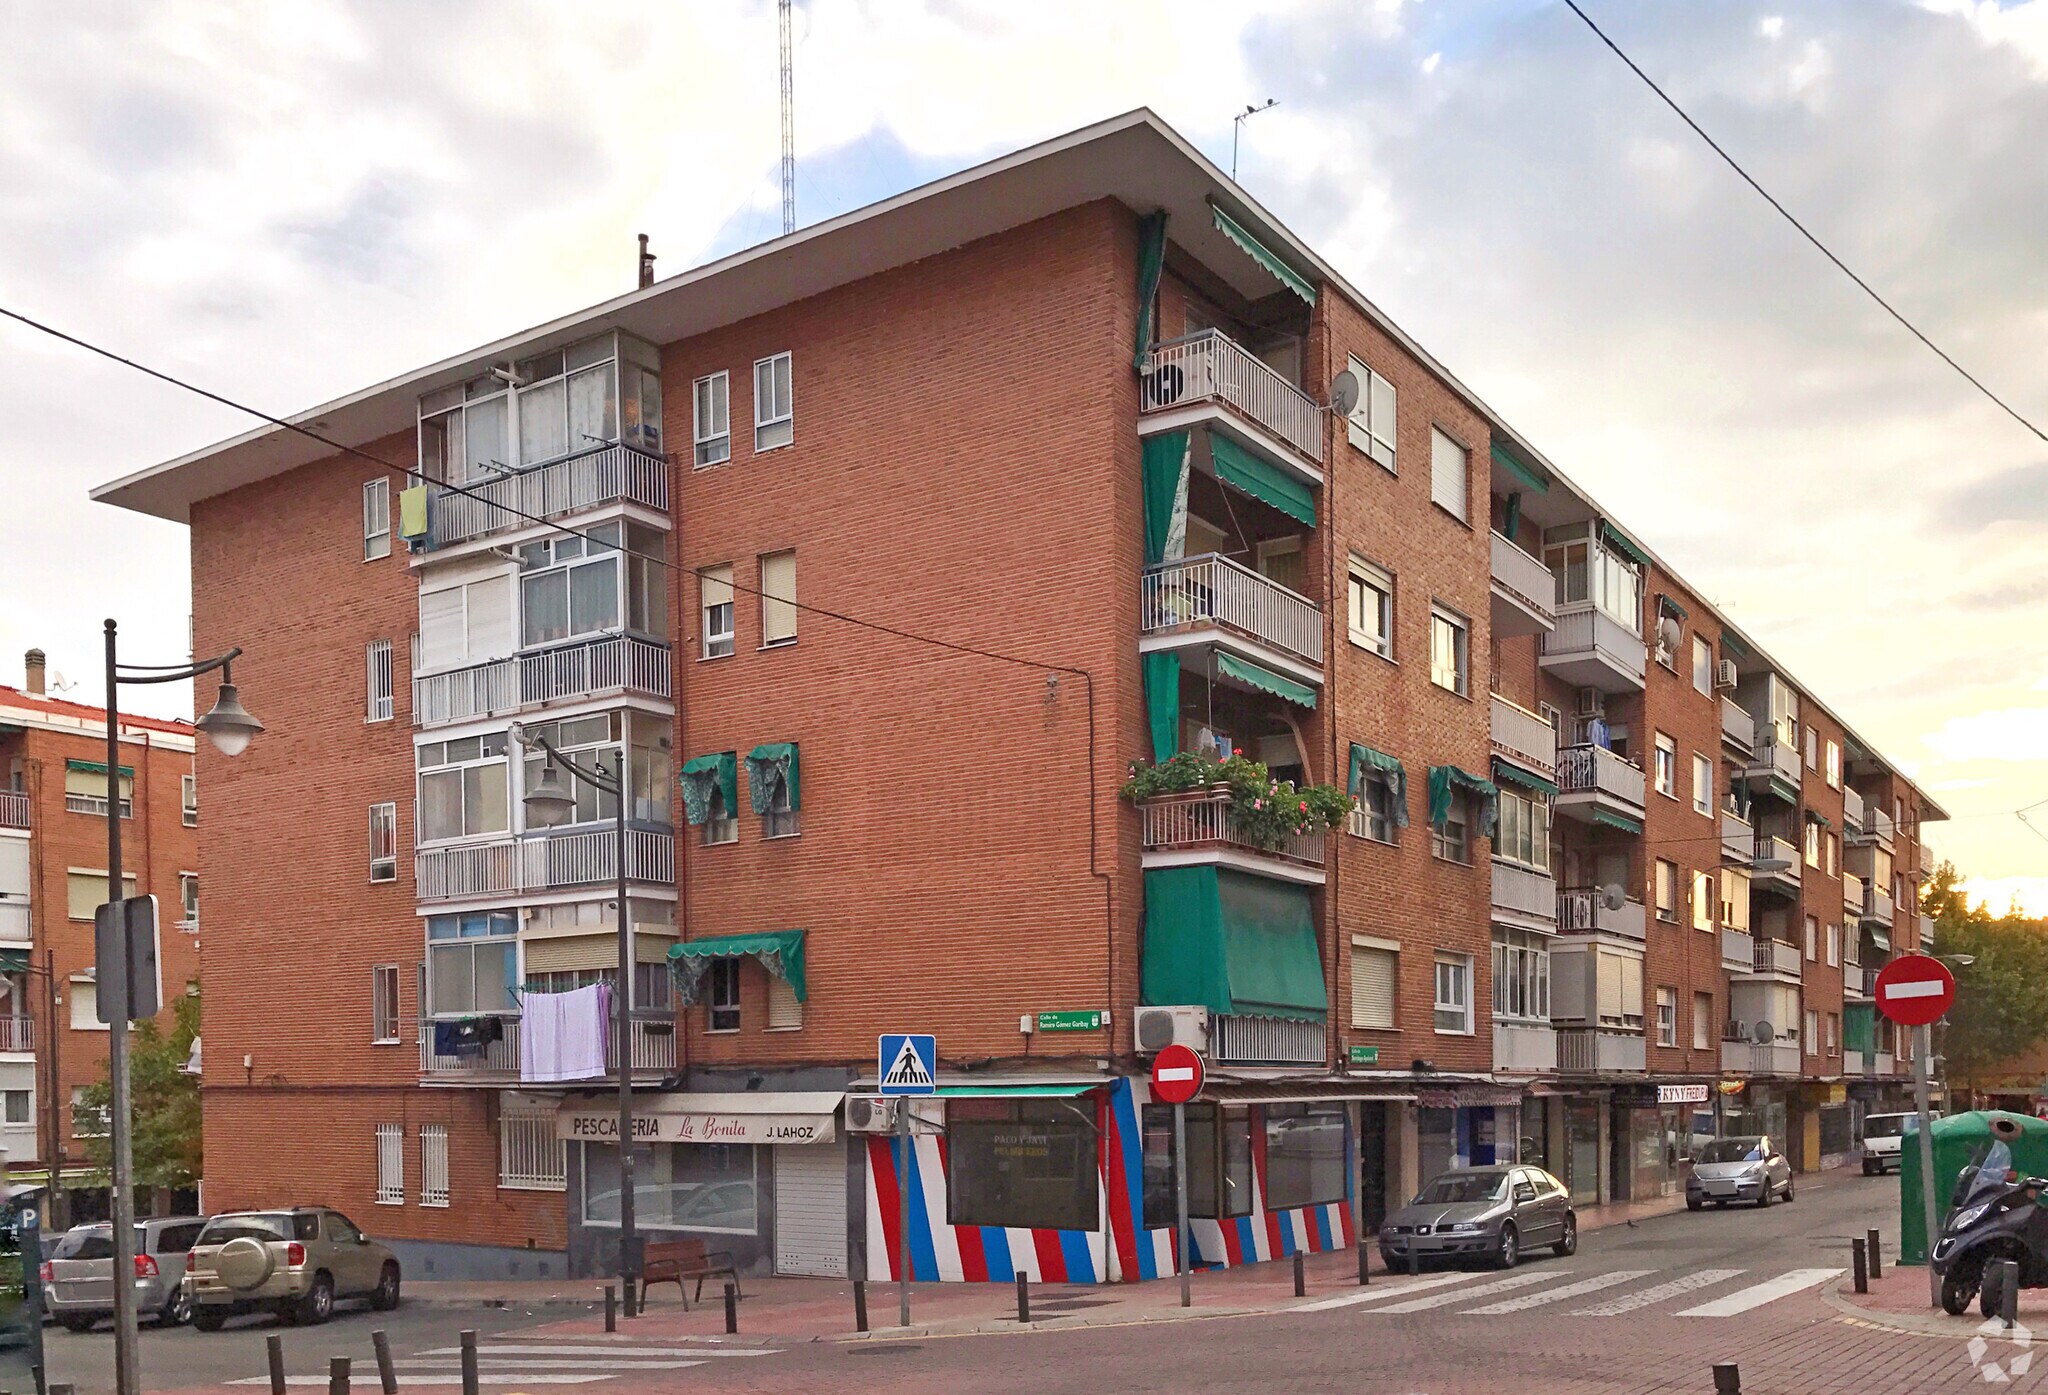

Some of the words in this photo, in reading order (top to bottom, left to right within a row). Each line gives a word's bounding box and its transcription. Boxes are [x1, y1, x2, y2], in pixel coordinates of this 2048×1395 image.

[573, 1118, 659, 1136] PESCAERIA
[676, 1116, 694, 1139] La
[702, 1116, 746, 1139] Bonita
[766, 1127, 775, 1138] J.
[777, 1126, 814, 1138] LAHOZ
[994, 1135, 1017, 1145] PACO
[1019, 1135, 1025, 1145] Y
[23, 1209, 36, 1228] P
